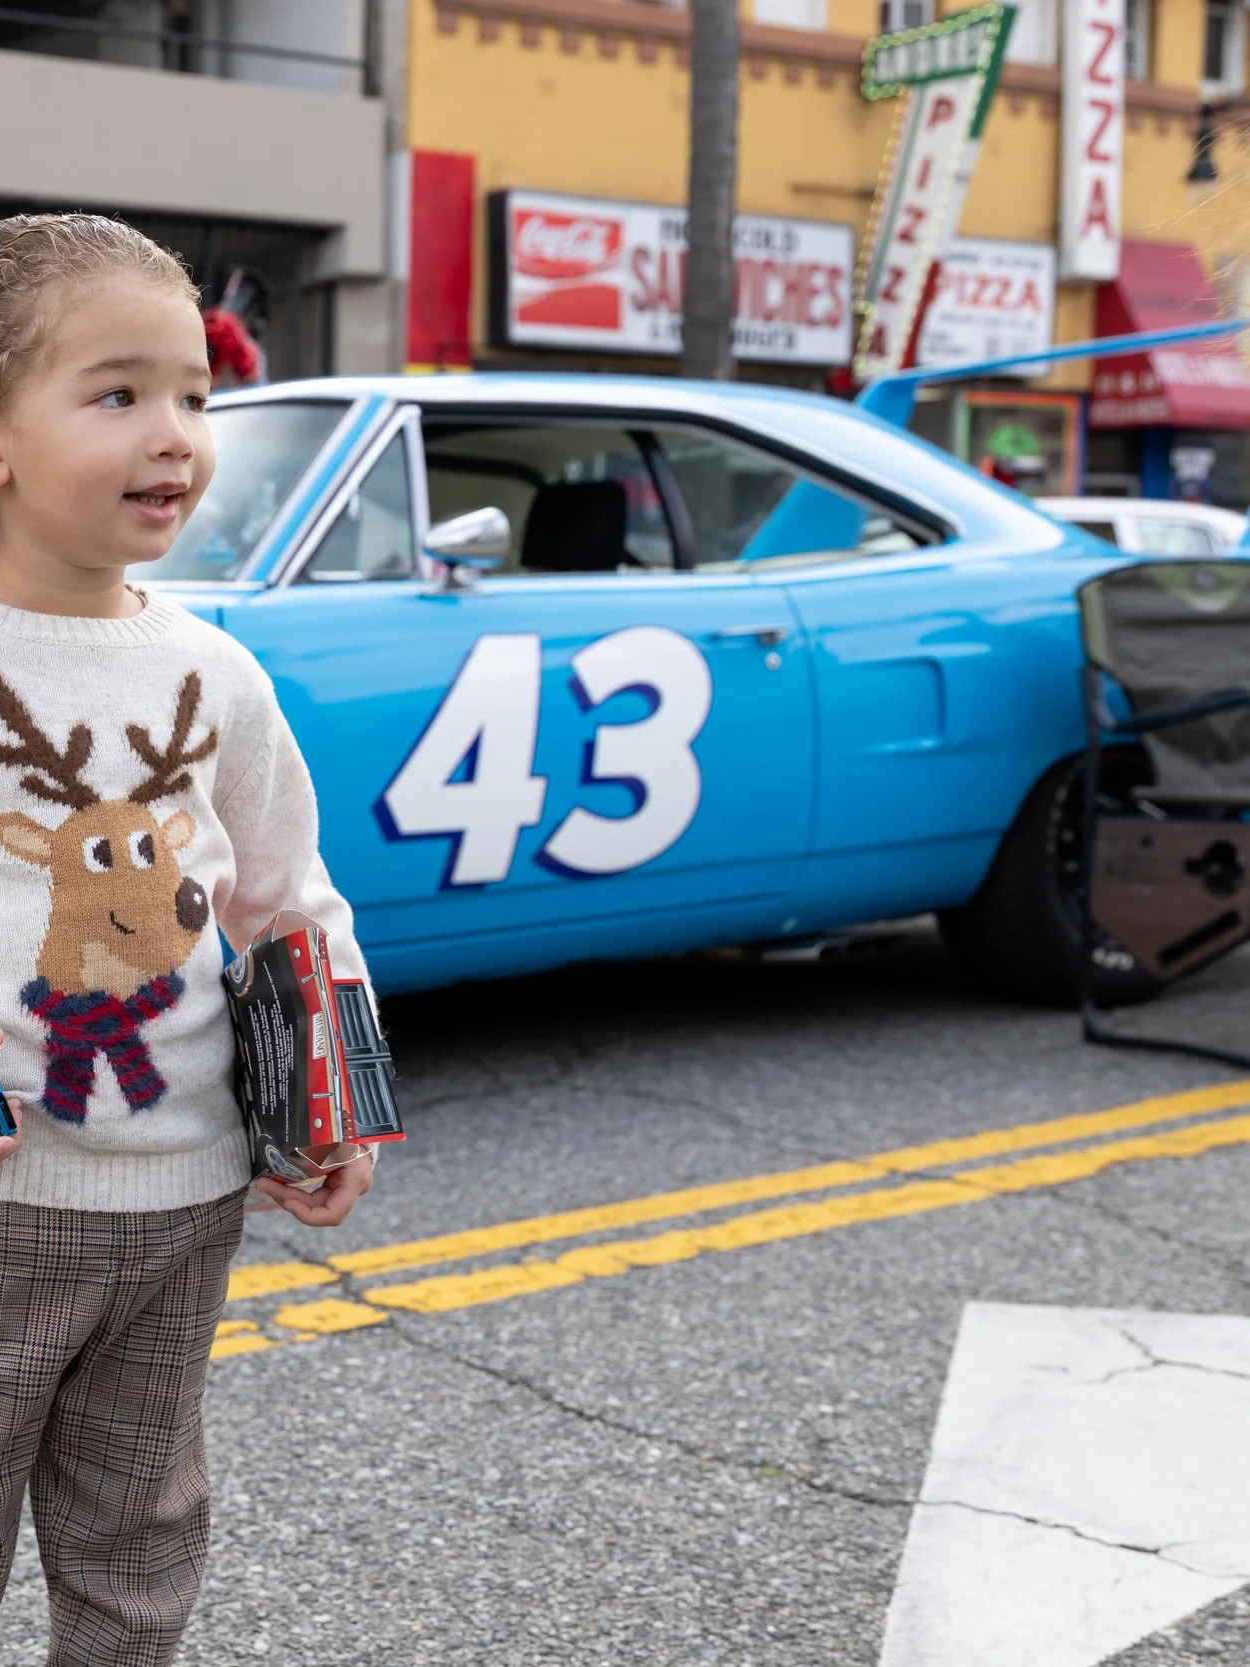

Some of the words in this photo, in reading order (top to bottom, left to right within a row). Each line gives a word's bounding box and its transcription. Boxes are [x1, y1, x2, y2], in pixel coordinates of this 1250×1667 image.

[867, 95, 956, 358] PIZZA
[1082, 0, 1117, 241] ZZA
[936, 271, 1040, 313] PIZZA
[374, 624, 713, 892] 43
[315, 1014, 326, 1056] MUSTANG
